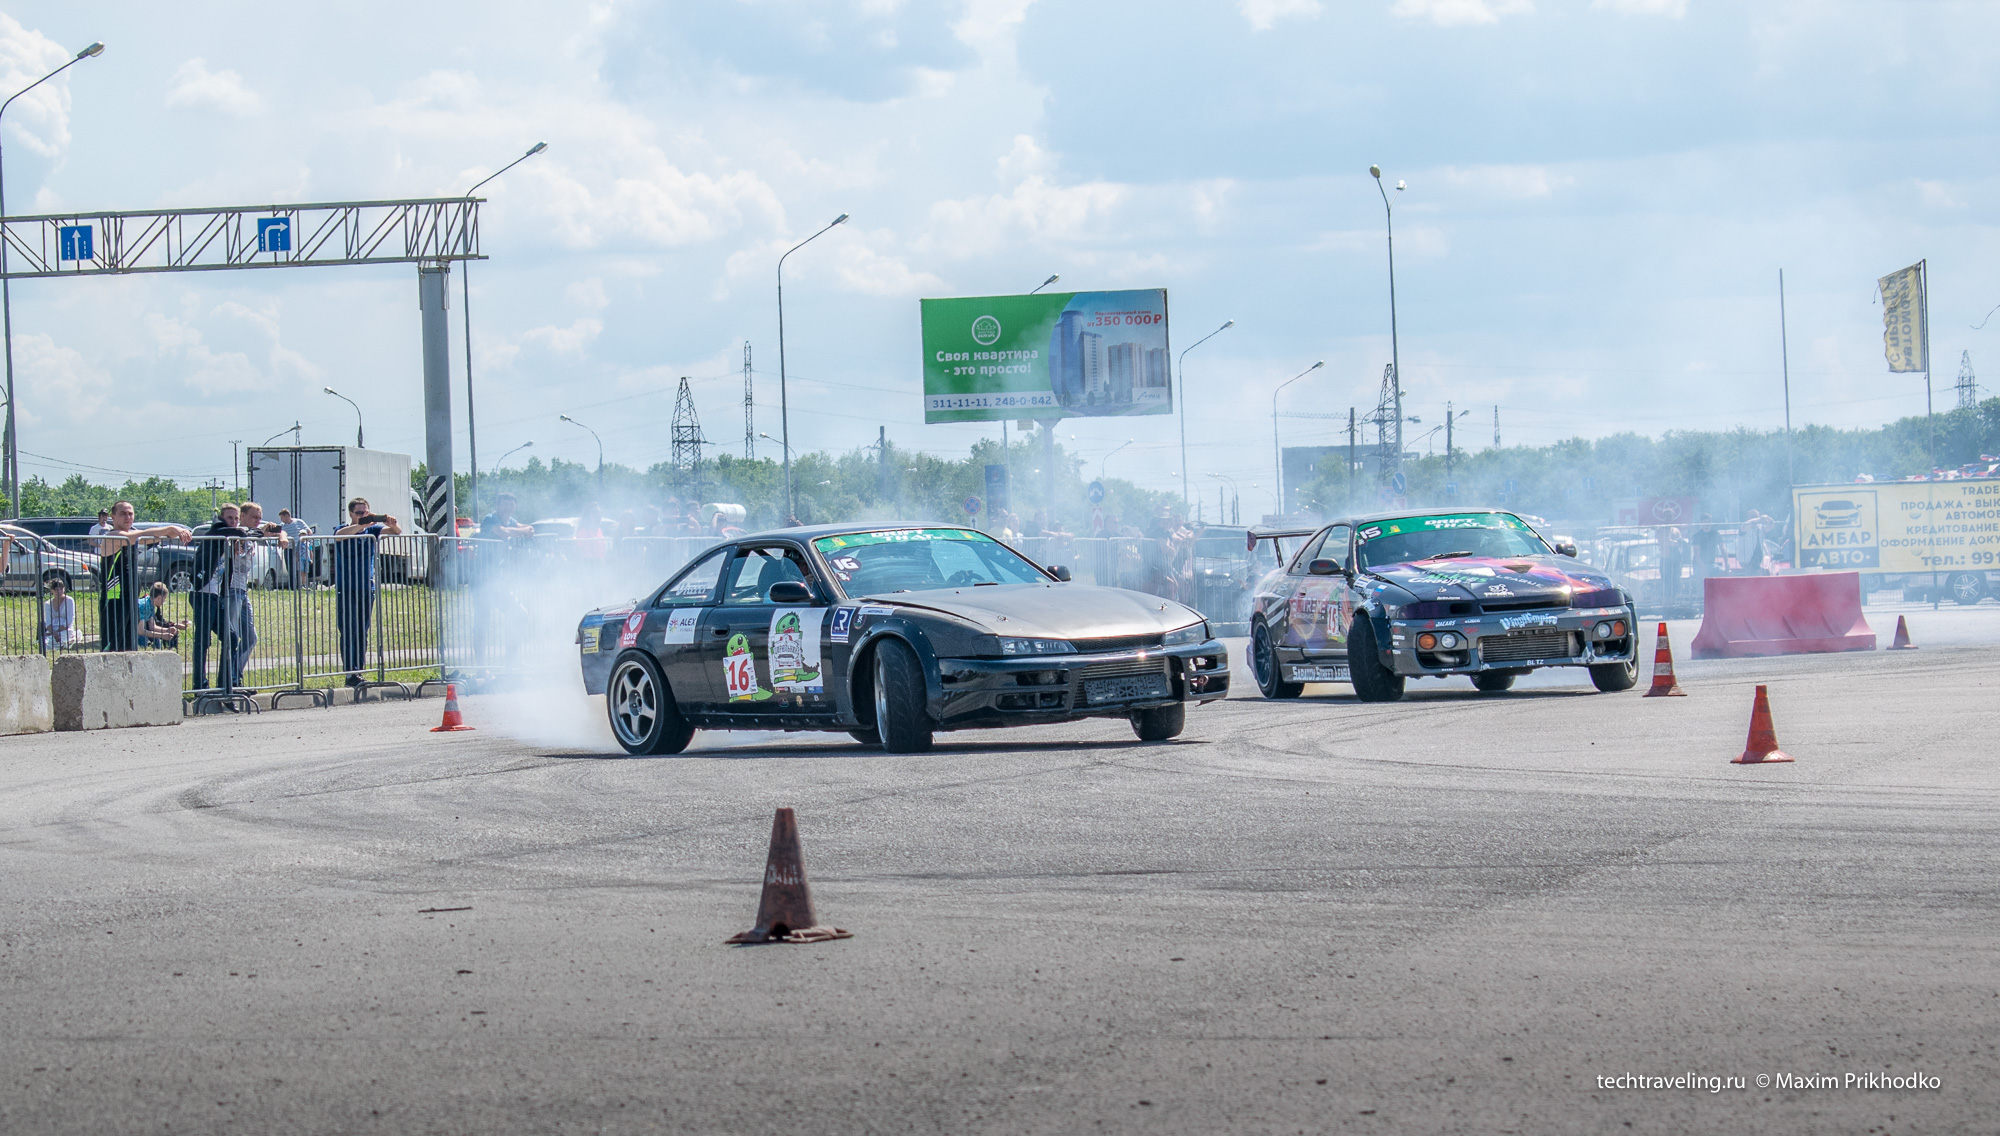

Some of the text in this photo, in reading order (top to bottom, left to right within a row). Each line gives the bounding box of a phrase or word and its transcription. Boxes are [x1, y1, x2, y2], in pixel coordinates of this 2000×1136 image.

[1095, 316, 1121, 326] 350
[936, 350, 1039, 362] Своя квартира
[953, 366, 976, 376] это
[980, 363, 1032, 377] просто!
[933, 396, 1052, 408] 311-11-11, 248-0-842
[1901, 500, 1964, 511] ПРОДАЖА
[870, 529, 924, 538] DRIFT
[1906, 523, 1999, 535] КРЕДИТОВАНИЕ
[1808, 531, 1871, 546] АМБАР
[1880, 536, 1965, 548] ОФОРМЛЕНИЕ
[1816, 550, 1864, 565] АВТО
[1921, 555, 1966, 567] тел.:
[833, 557, 860, 571] 16
[679, 618, 697, 626] ALEX
[1328, 606, 1337, 634] 15
[624, 632, 637, 640] LOVE
[728, 658, 750, 691] 16
